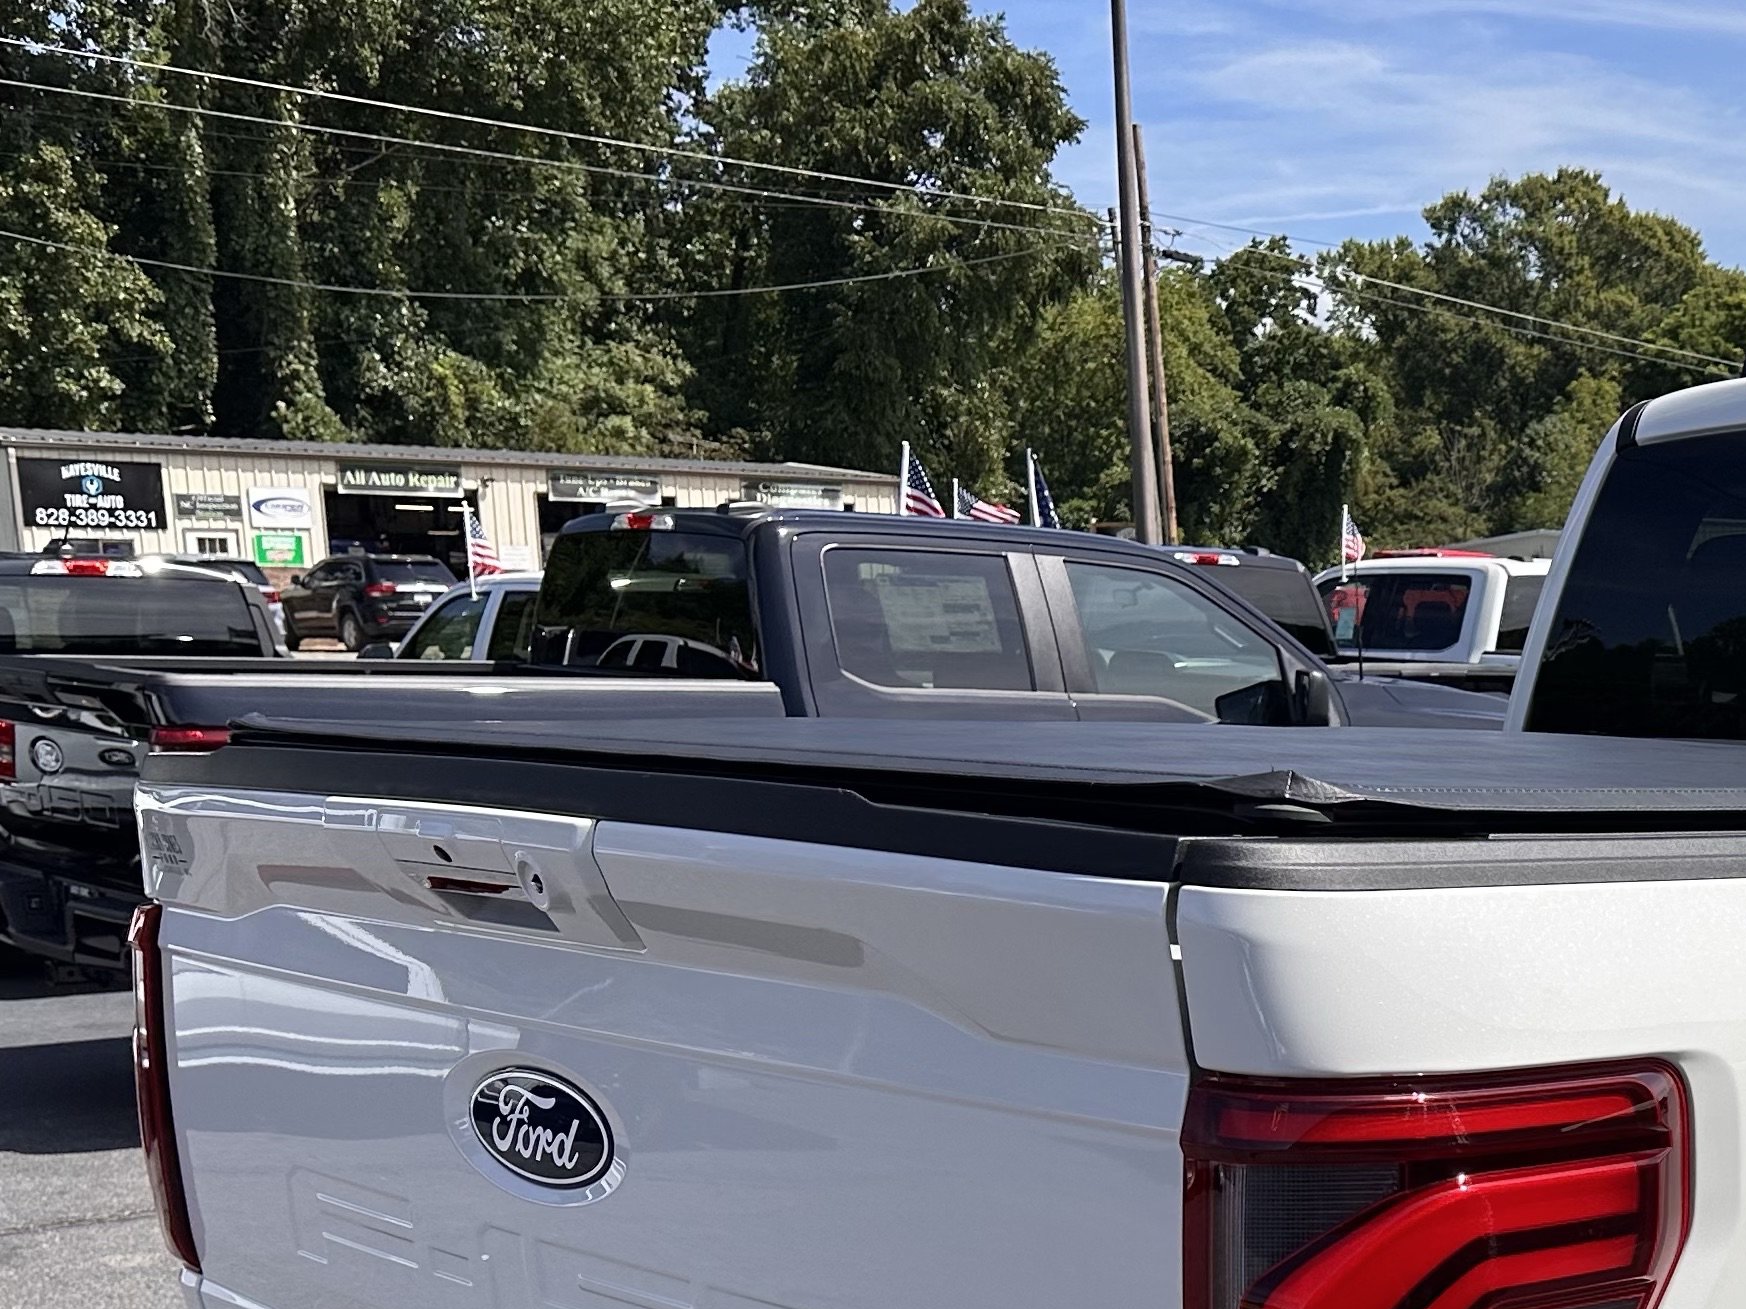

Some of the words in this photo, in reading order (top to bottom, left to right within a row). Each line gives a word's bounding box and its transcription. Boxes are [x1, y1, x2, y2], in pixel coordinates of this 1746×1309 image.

[343, 469, 366, 486] All
[368, 471, 405, 487] Auto
[408, 471, 458, 492] Repair
[35, 507, 157, 528] 828-389-3331
[492, 1084, 581, 1171] Ford
